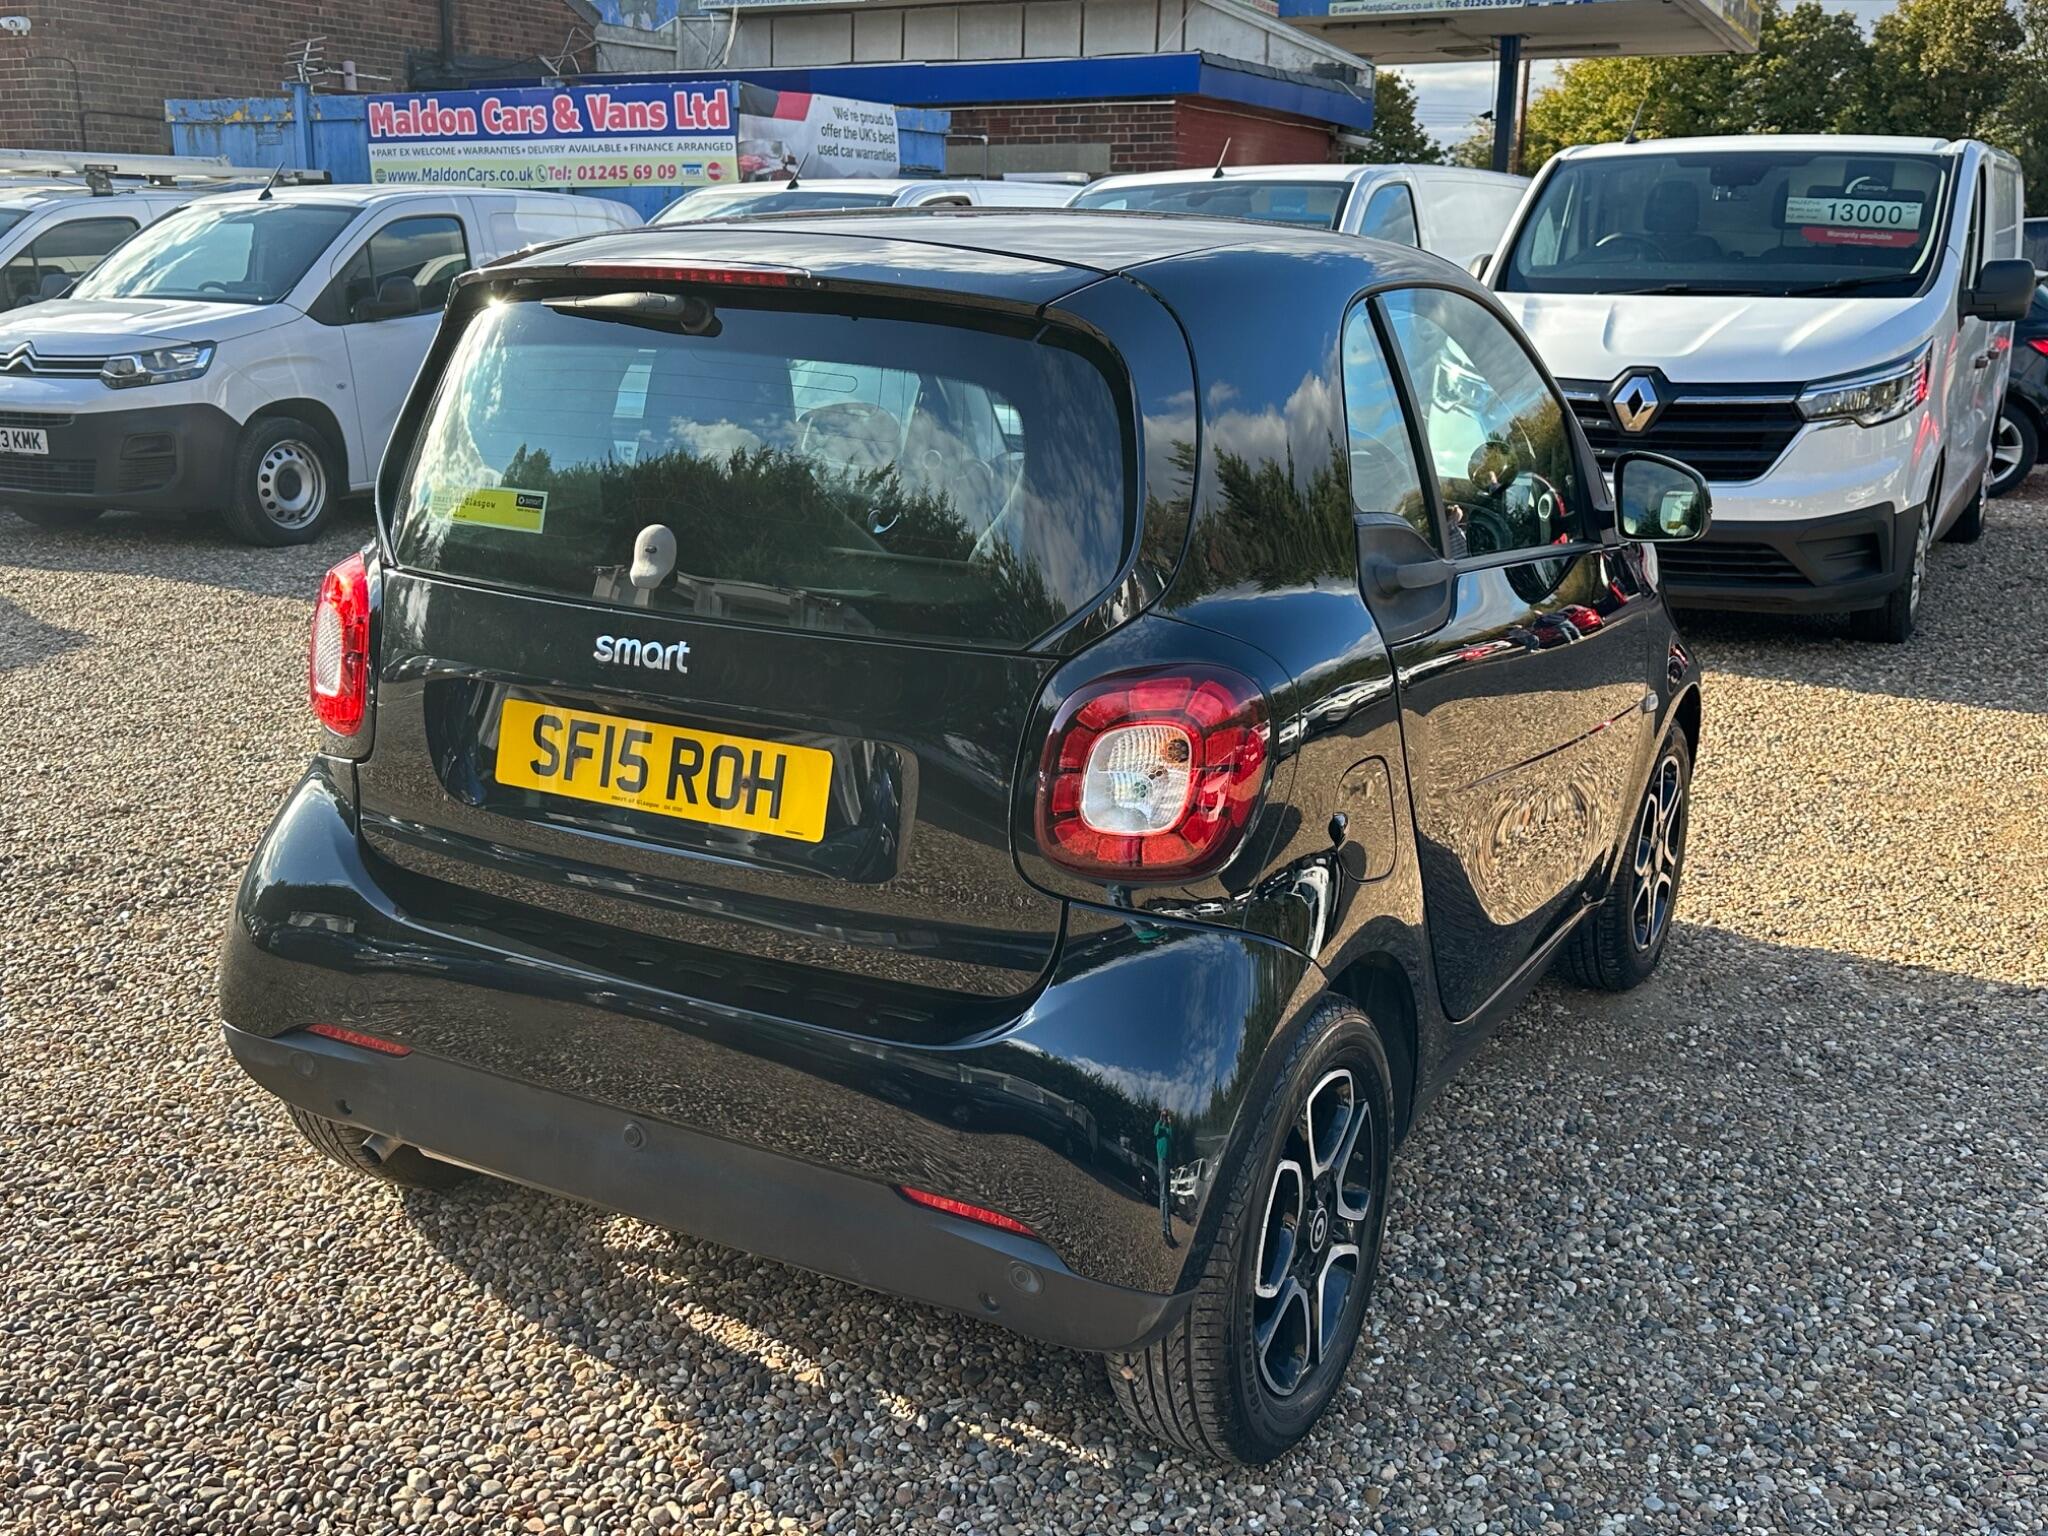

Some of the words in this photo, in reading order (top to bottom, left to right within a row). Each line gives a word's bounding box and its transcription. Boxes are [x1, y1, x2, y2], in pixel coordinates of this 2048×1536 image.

[368, 99, 477, 137] Maldon
[482, 97, 548, 134] Cars
[553, 95, 583, 132] &
[585, 93, 668, 131] Vans
[674, 89, 730, 130] Ltd
[833, 106, 859, 122] We're
[860, 112, 884, 126] proud
[885, 114, 894, 126] to
[821, 123, 842, 138] offer
[843, 126, 858, 140] the
[859, 127, 877, 142] UK's
[878, 130, 896, 144] best
[376, 148, 397, 157] PART
[400, 147, 411, 156] EX
[411, 147, 456, 156] WELCOME
[462, 145, 521, 155] WARRANTIES
[527, 144, 565, 154] DELIVERY
[568, 143, 621, 153] AVAILABLE
[630, 142, 673, 152] FINANCE
[676, 141, 733, 151] ARRANGED
[817, 143, 839, 157] used
[841, 146, 854, 158] car
[855, 148, 897, 162] warranties
[388, 167, 533, 182] www.MaldonCars.co.uk
[548, 166, 573, 180] Tel:
[577, 165, 628, 180] 01245
[633, 164, 653, 180] 69
[657, 164, 677, 179] 09
[1828, 203, 1903, 224] 13000
[12, 431, 42, 450] KMK
[593, 634, 690, 674] smart
[530, 714, 652, 793] SF15
[666, 736, 787, 820] ROH
